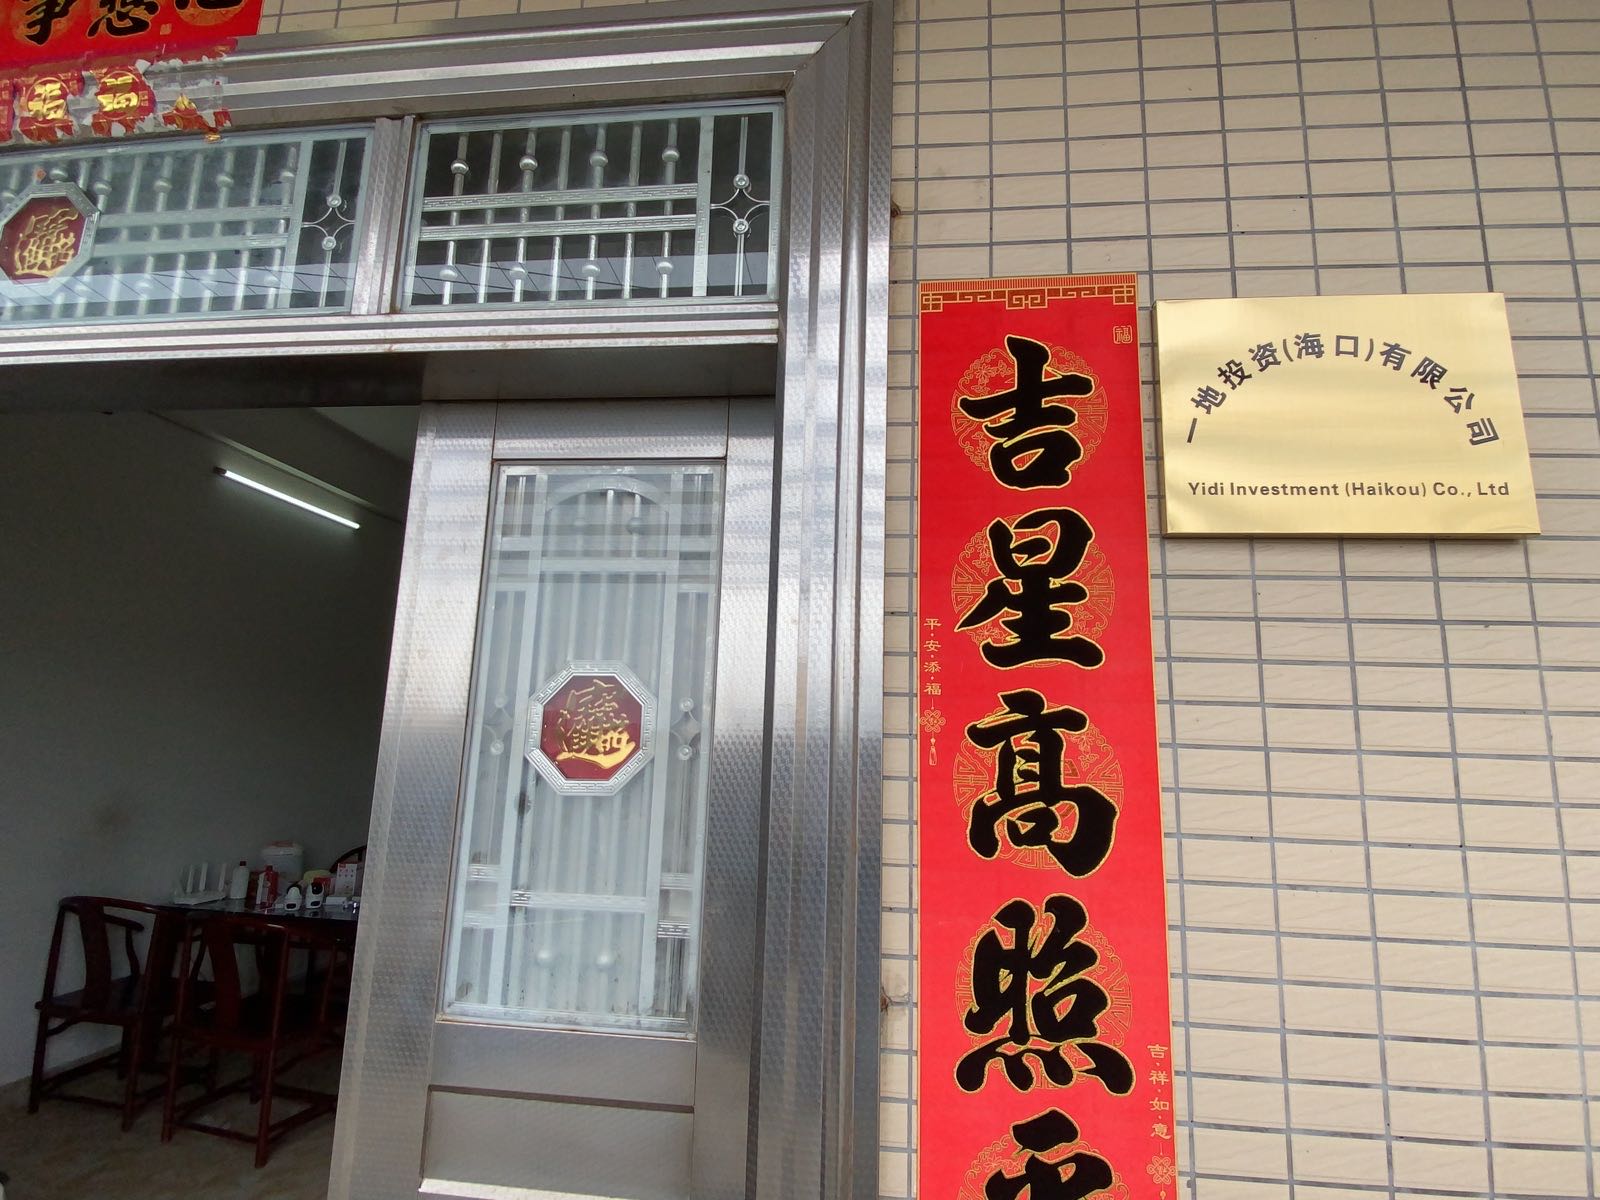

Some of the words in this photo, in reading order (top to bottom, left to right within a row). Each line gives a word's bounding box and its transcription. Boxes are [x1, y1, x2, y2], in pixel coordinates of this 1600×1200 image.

[1187, 332, 1500, 446] 一地投资(海口)有限公司
[1188, 481, 1225, 496] Yidi
[1230, 481, 1340, 496] Investment
[1345, 481, 1427, 498] (Haikou)
[1433, 481, 1472, 498] Co.,
[1477, 481, 1510, 496] Ltd
